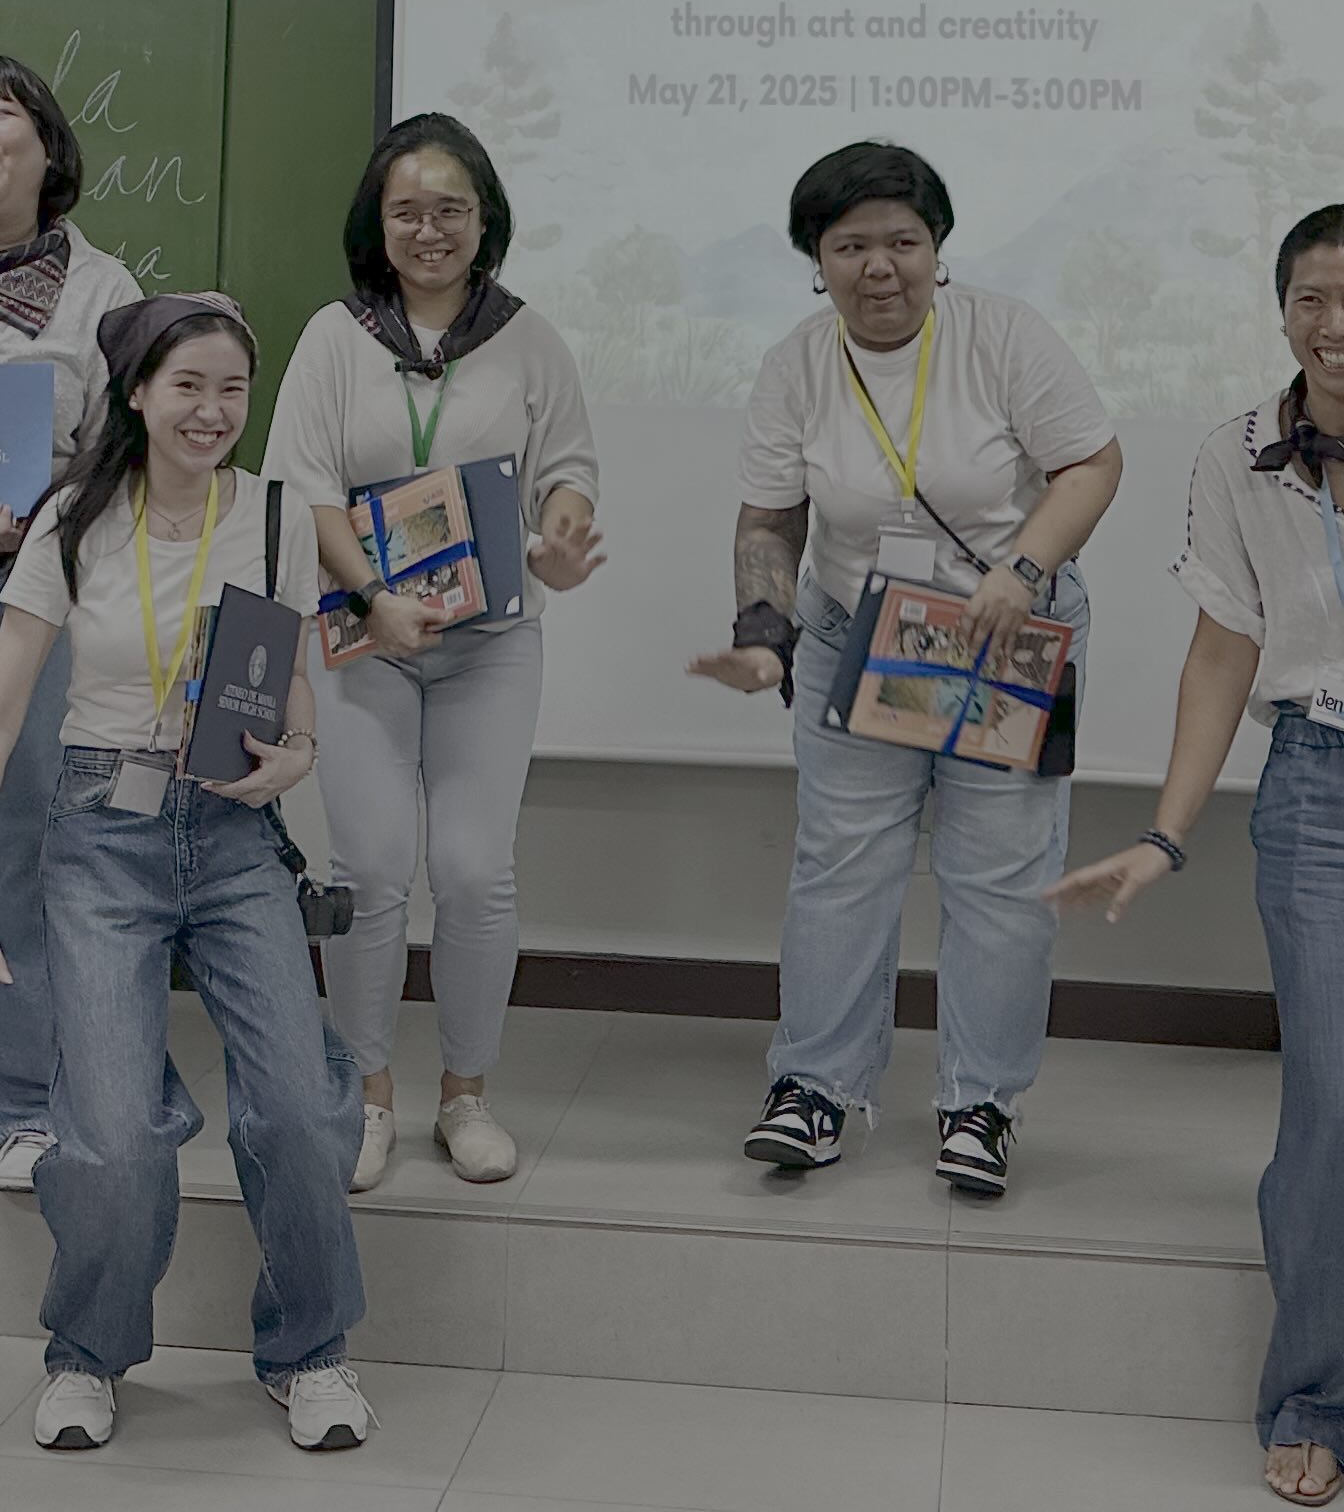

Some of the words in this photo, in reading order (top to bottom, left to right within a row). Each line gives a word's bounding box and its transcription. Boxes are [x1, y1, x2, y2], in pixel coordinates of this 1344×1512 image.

[670, 2, 796, 49] through
[807, 7, 855, 40] art
[864, 3, 927, 40] and
[937, 7, 1099, 52] creativity
[628, 72, 698, 117] May
[706, 74, 748, 115] 21,
[760, 74, 838, 109] 2025
[869, 76, 1143, 113] 1:00PM-3:00PM
[1316, 688, 1344, 714] Jen
